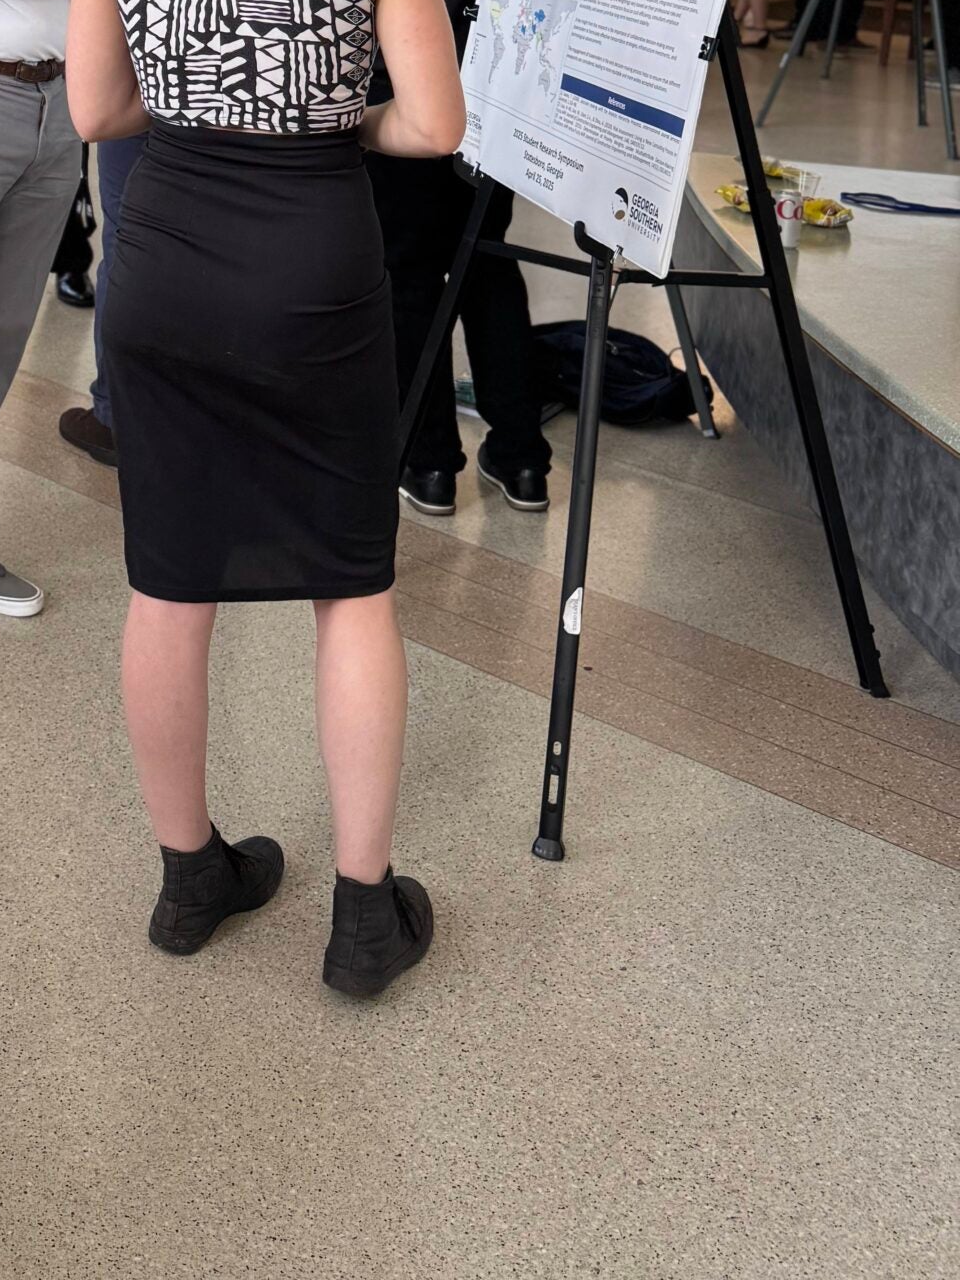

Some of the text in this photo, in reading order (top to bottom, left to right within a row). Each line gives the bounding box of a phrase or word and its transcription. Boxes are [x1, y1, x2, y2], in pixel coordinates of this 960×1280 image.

[608, 97, 626, 110] References
[513, 128, 584, 172] 2025 Student Research Symposium
[523, 150, 564, 179] Statesboro, Georgia
[525, 168, 536, 181] April
[543, 178, 554, 191] 2025
[632, 194, 658, 218] GEORGIA
[627, 219, 660, 243] UNIVERSITY
[630, 207, 663, 234] SOUTHERN
